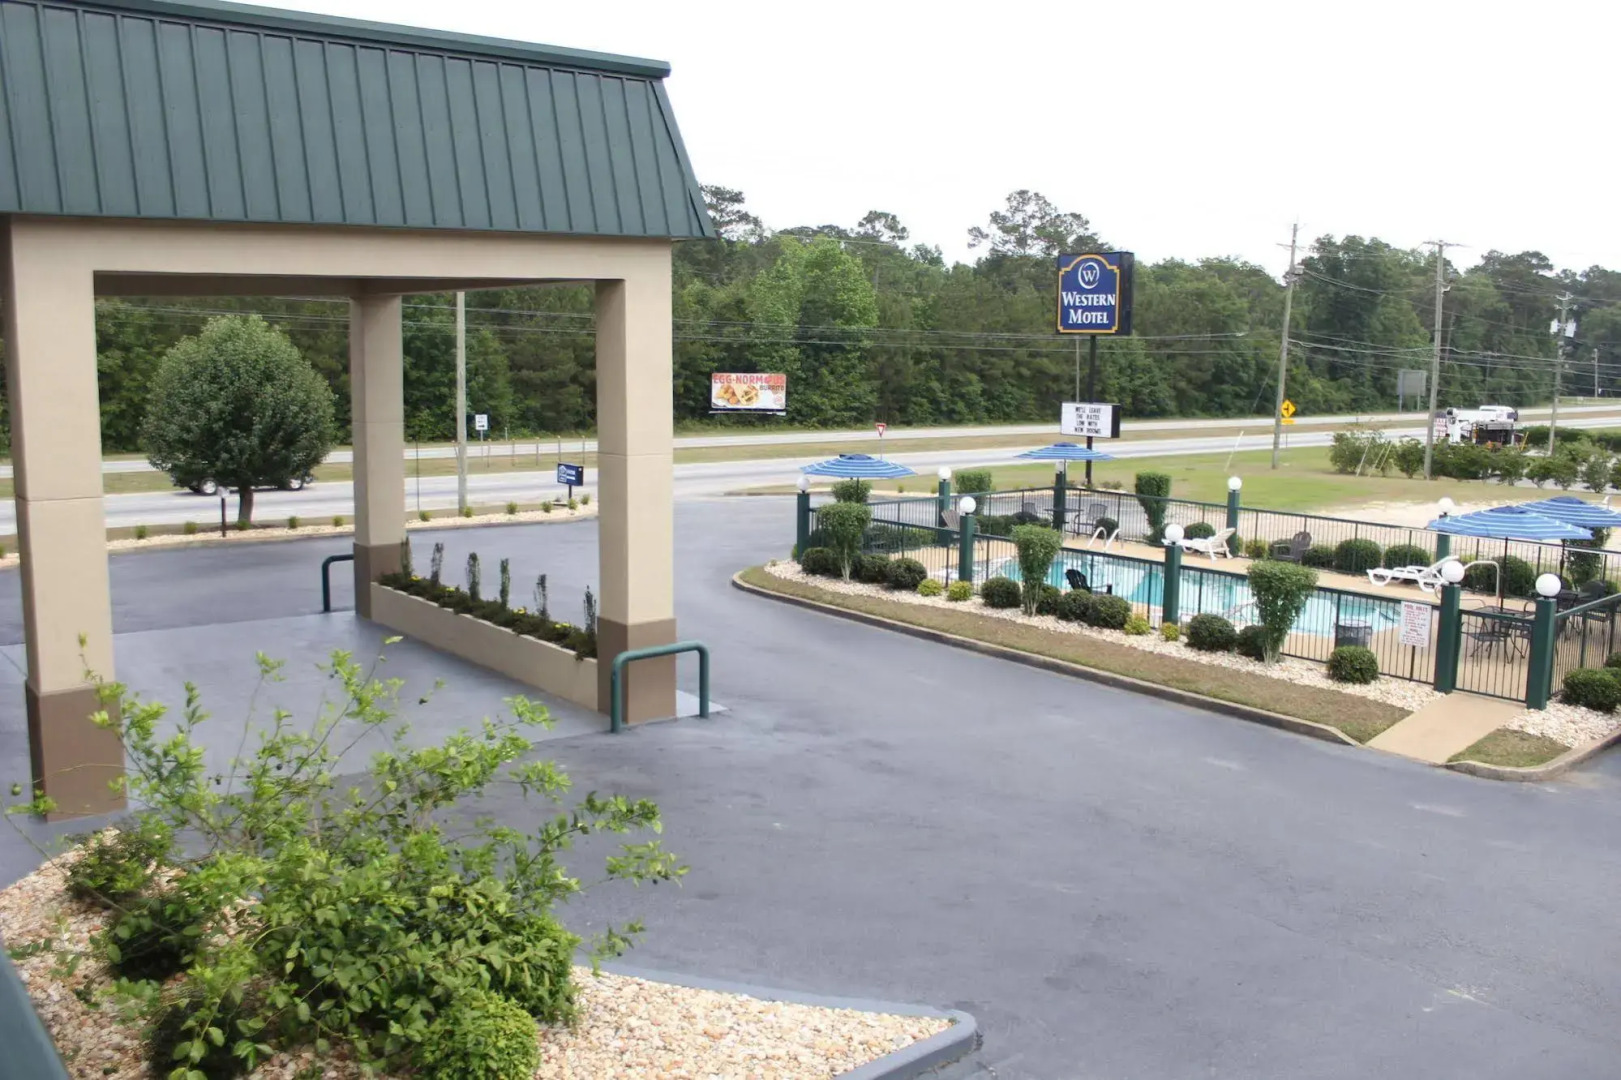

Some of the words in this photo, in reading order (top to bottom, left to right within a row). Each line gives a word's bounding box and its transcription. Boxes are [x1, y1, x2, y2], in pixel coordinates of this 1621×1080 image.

[1082, 270, 1097, 282] W
[1061, 291, 1116, 306] WESTERN
[1068, 308, 1109, 324] MOTEL
